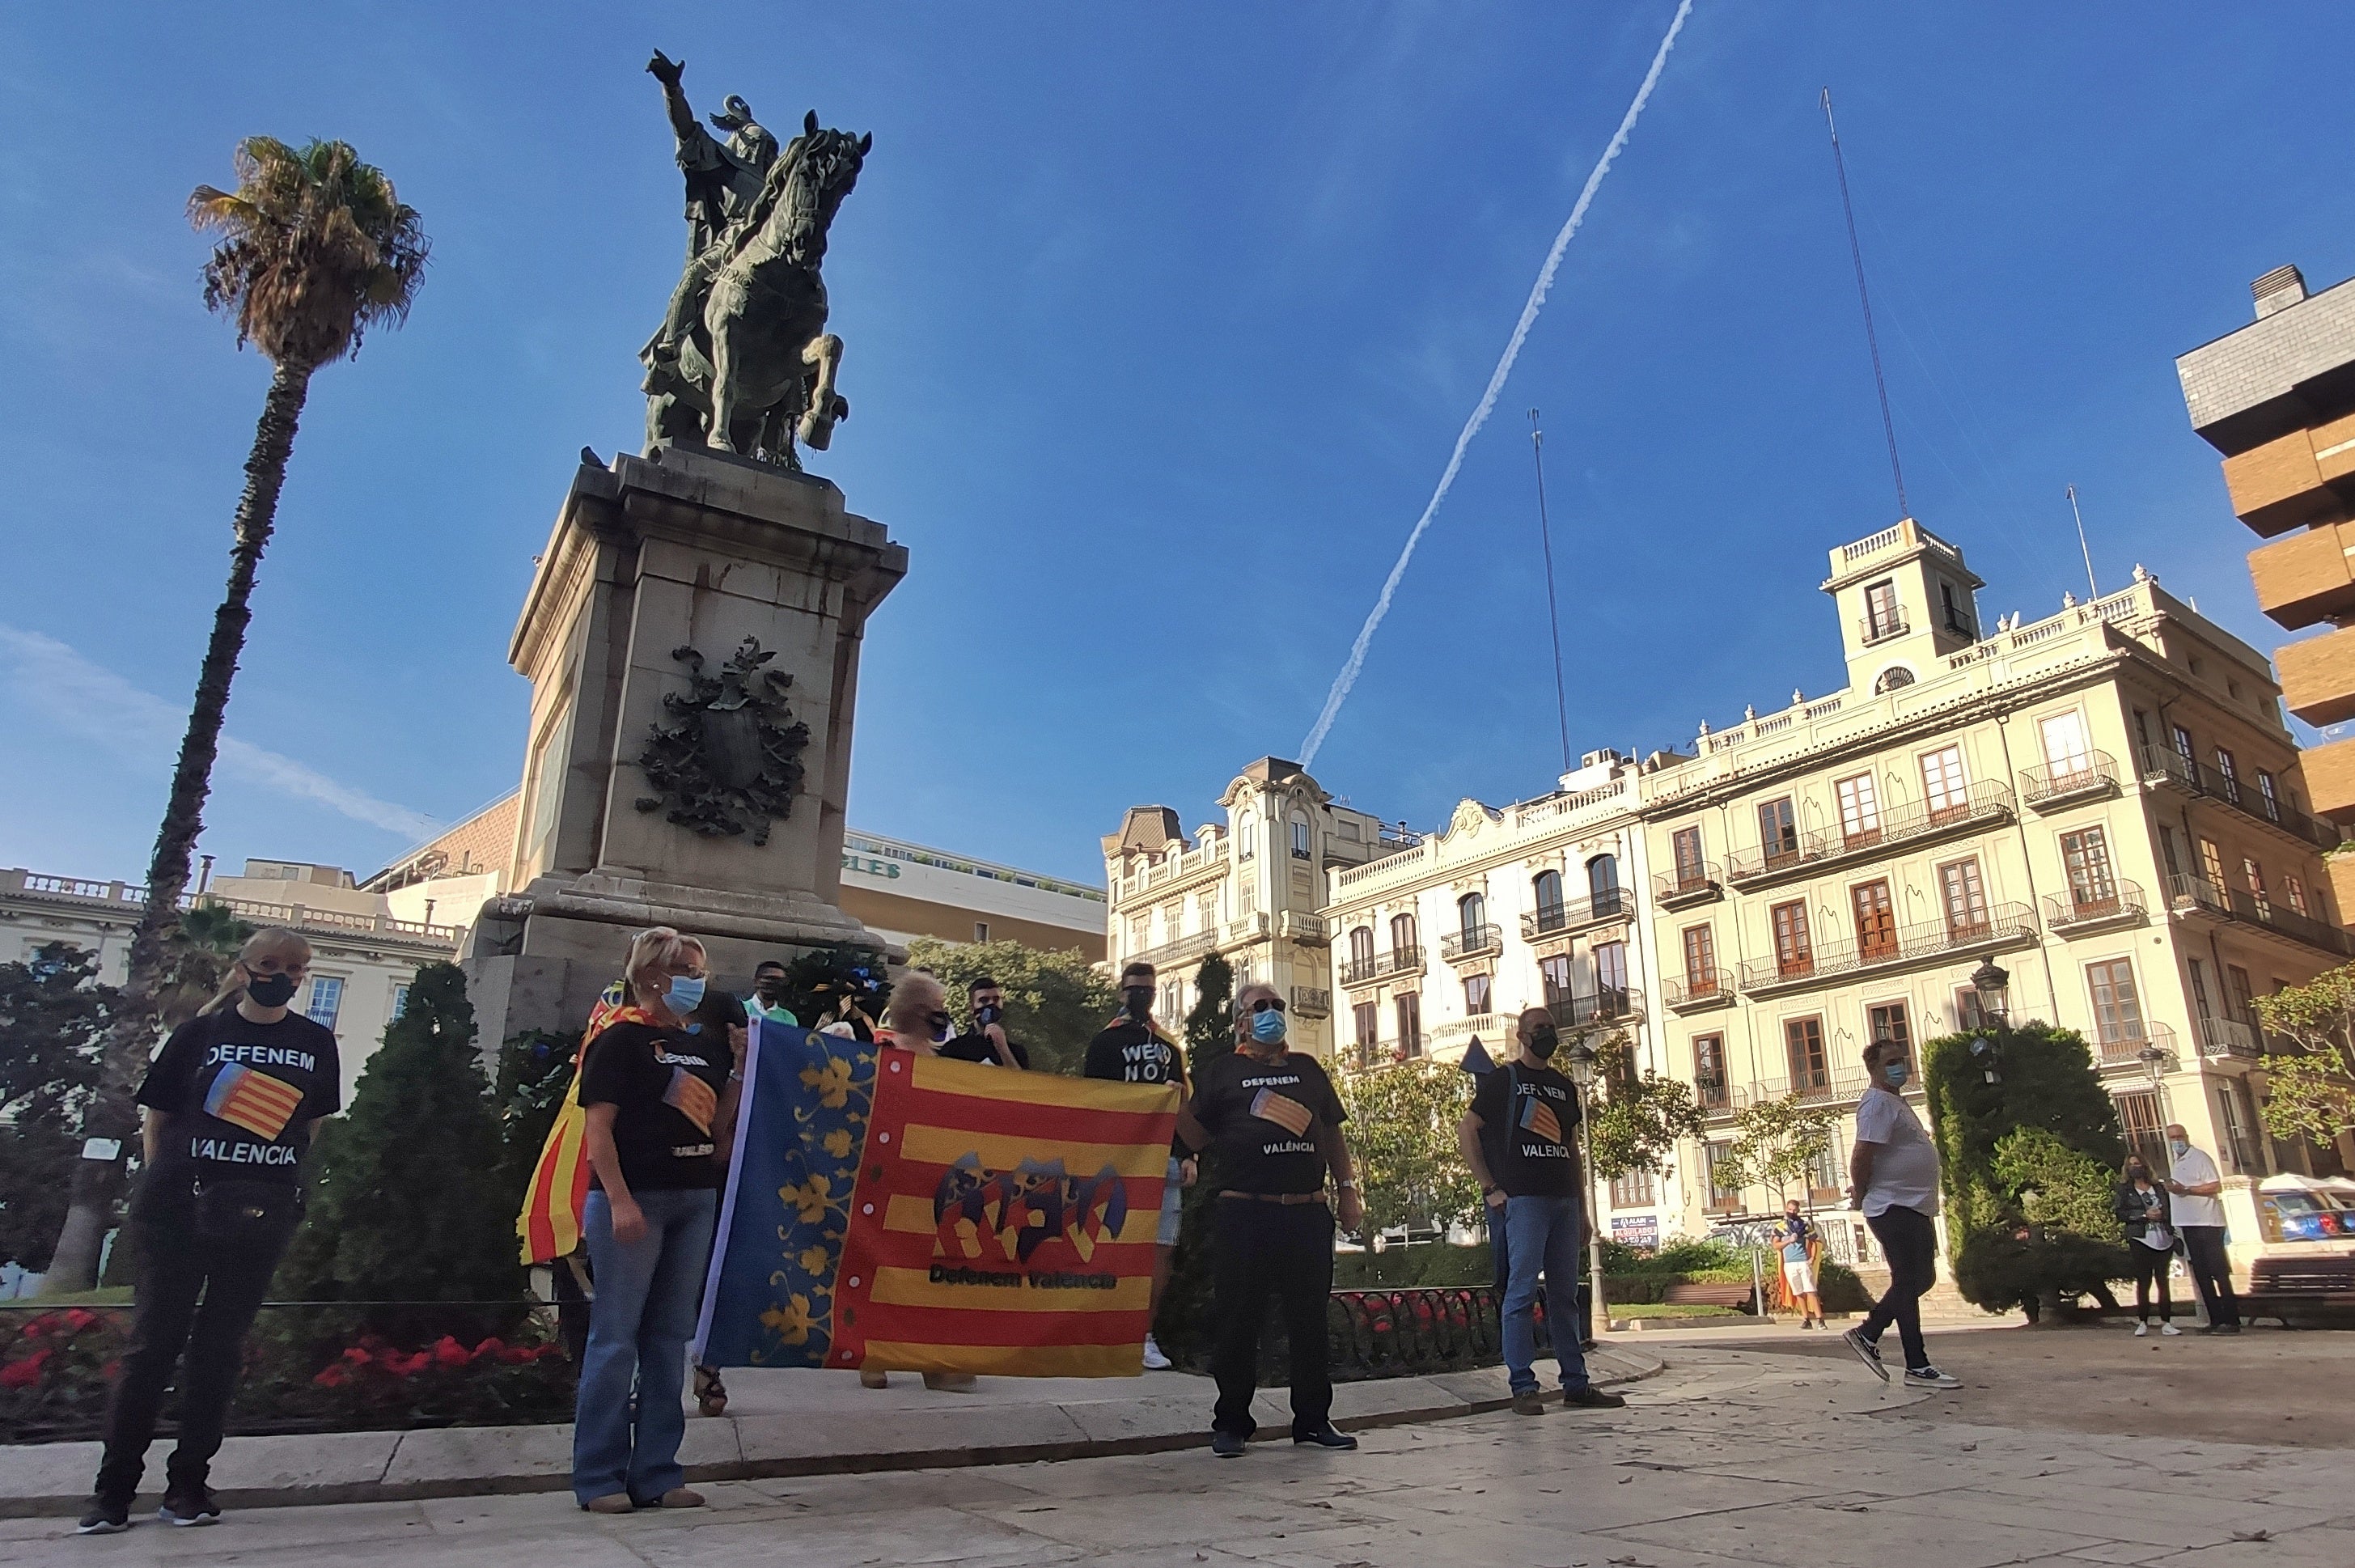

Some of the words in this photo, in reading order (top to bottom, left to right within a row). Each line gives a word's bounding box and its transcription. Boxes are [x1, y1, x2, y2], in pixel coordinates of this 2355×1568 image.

[206, 1044, 316, 1072] DEFENEM
[1242, 1075, 1300, 1088] DEFENEM
[1517, 1083, 1566, 1101] DEFNEM
[1615, 1227, 1652, 1237] ALQUILADO
